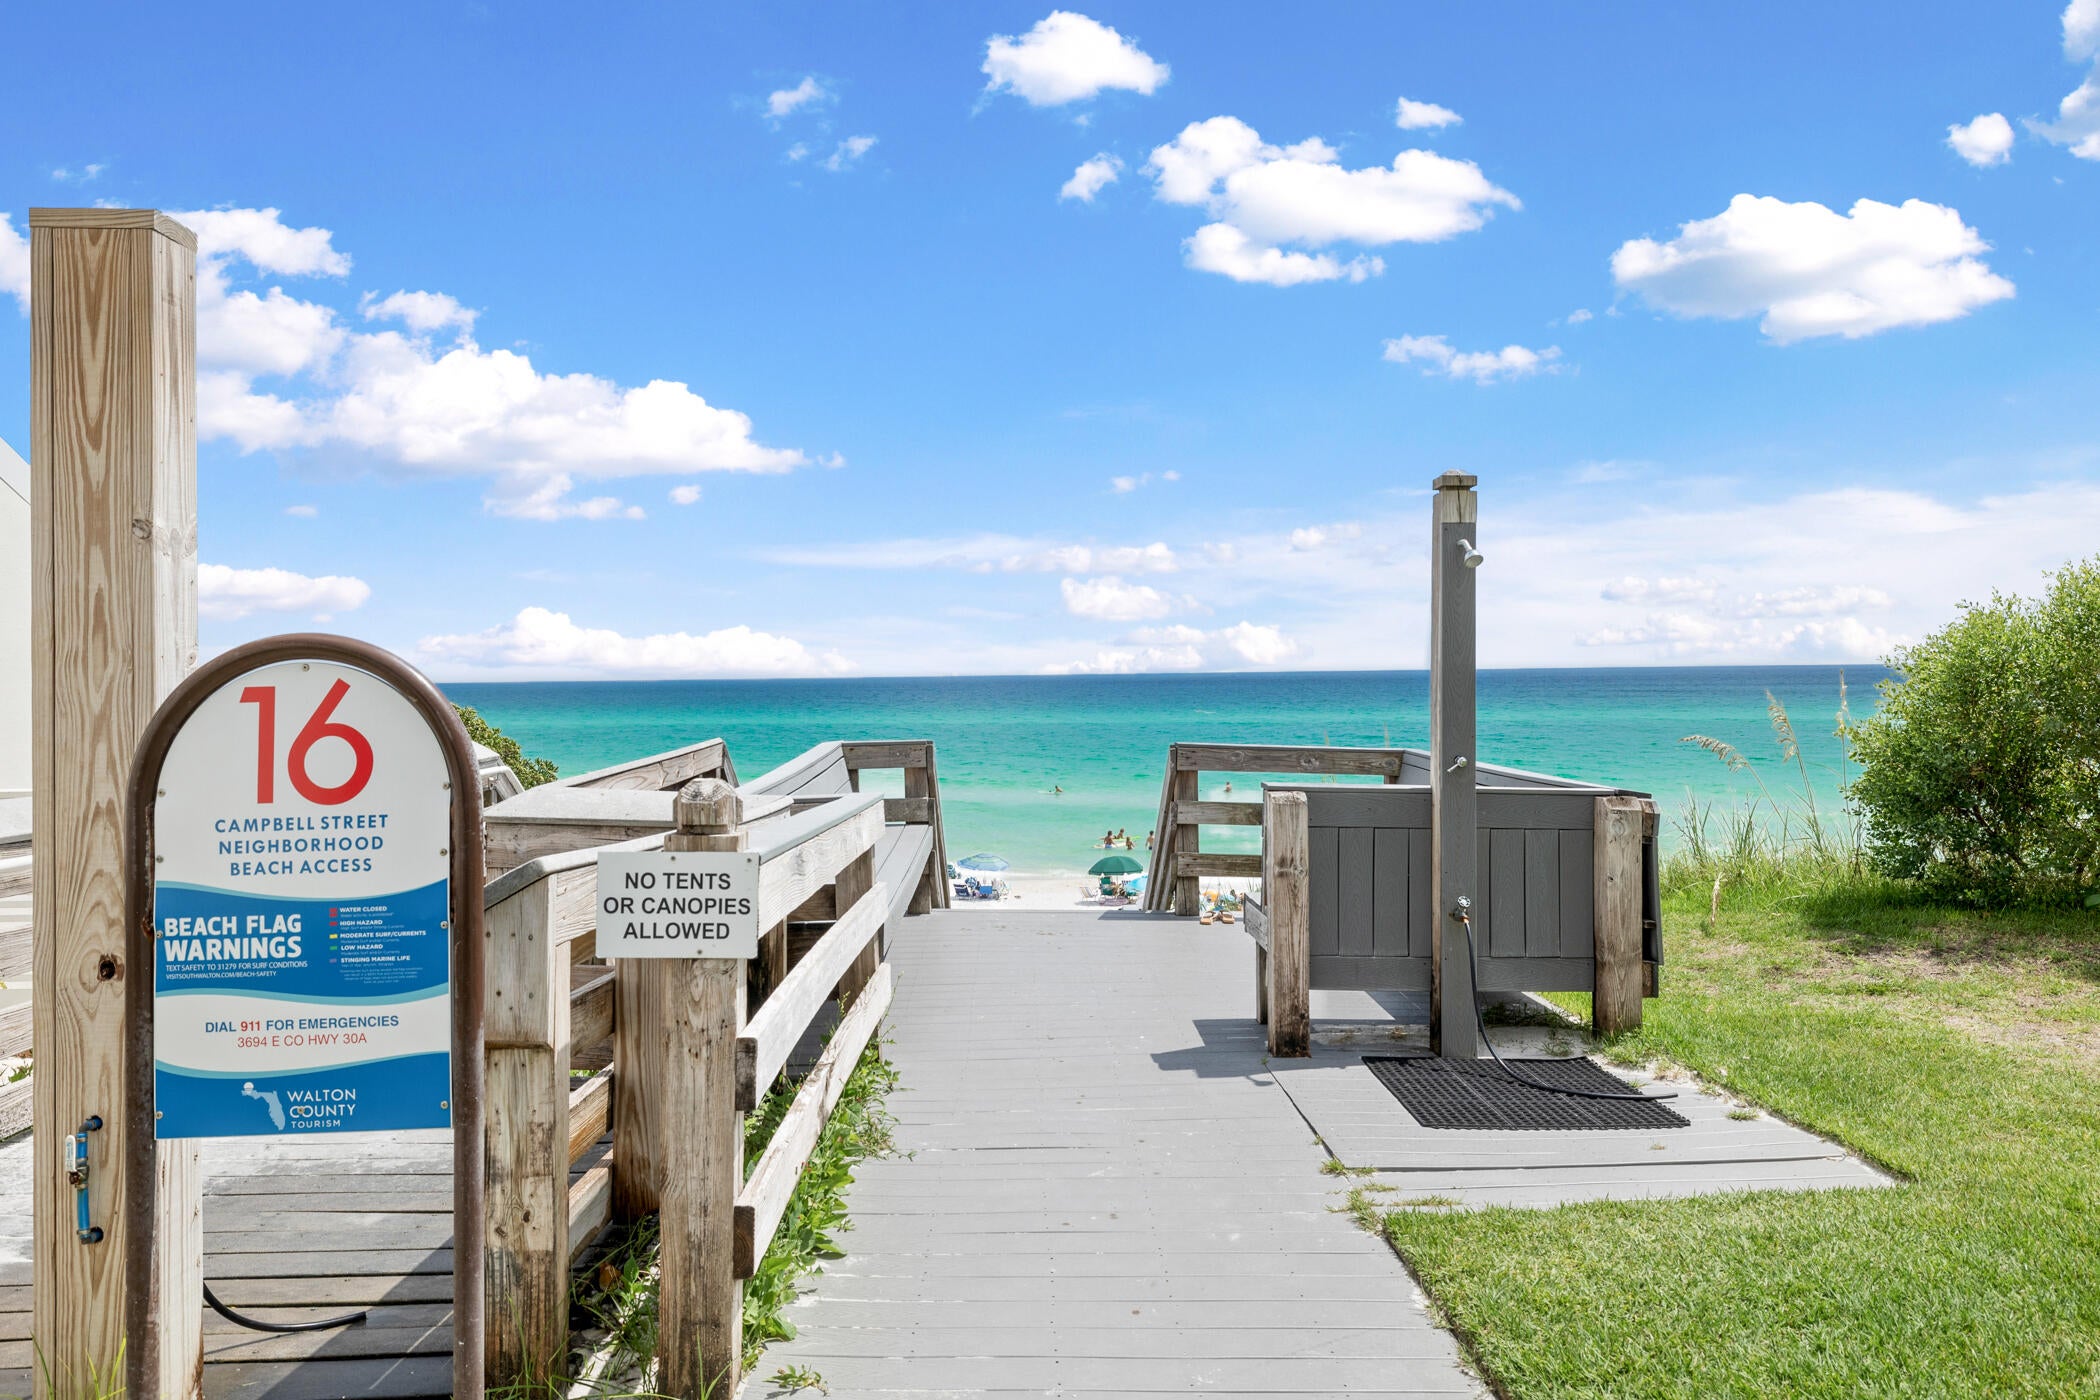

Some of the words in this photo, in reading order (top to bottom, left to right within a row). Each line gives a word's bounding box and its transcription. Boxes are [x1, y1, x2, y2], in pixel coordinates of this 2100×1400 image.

[239, 677, 374, 806] 16
[214, 816, 315, 833] CAMPBELL
[320, 814, 389, 830] STREET
[218, 836, 384, 855] NEIGHBORHOOD
[230, 860, 293, 876] BEACH
[299, 858, 373, 874] ACCESS
[625, 872, 656, 889] NO
[662, 872, 731, 890] TENTS
[603, 896, 635, 914] OR
[641, 897, 751, 915] CANOPIES
[164, 915, 237, 937] BEACH
[246, 913, 302, 935] FLAG
[622, 922, 730, 939] ALLOWED
[163, 935, 303, 962] WARNINGS
[165, 964, 180, 972] TEXT
[207, 963, 217, 971] TO
[217, 962, 237, 970] 31279
[252, 961, 268, 969] SURF
[166, 971, 276, 980] VISITSOUTHWALTON.COM/BEACH-SAFETY
[205, 1021, 237, 1033] DIAL
[240, 1020, 261, 1032] 911
[266, 1019, 294, 1031] FOR
[299, 1015, 399, 1030] EMERGENCIES
[237, 1036, 267, 1048] 3694
[272, 1035, 279, 1046] E
[283, 1034, 304, 1047] CO
[308, 1033, 339, 1045] HWY
[343, 1033, 367, 1044] 30A
[286, 1088, 357, 1102] WALTON
[289, 1103, 357, 1118] COUNTY
[291, 1119, 341, 1129] TOURISM
